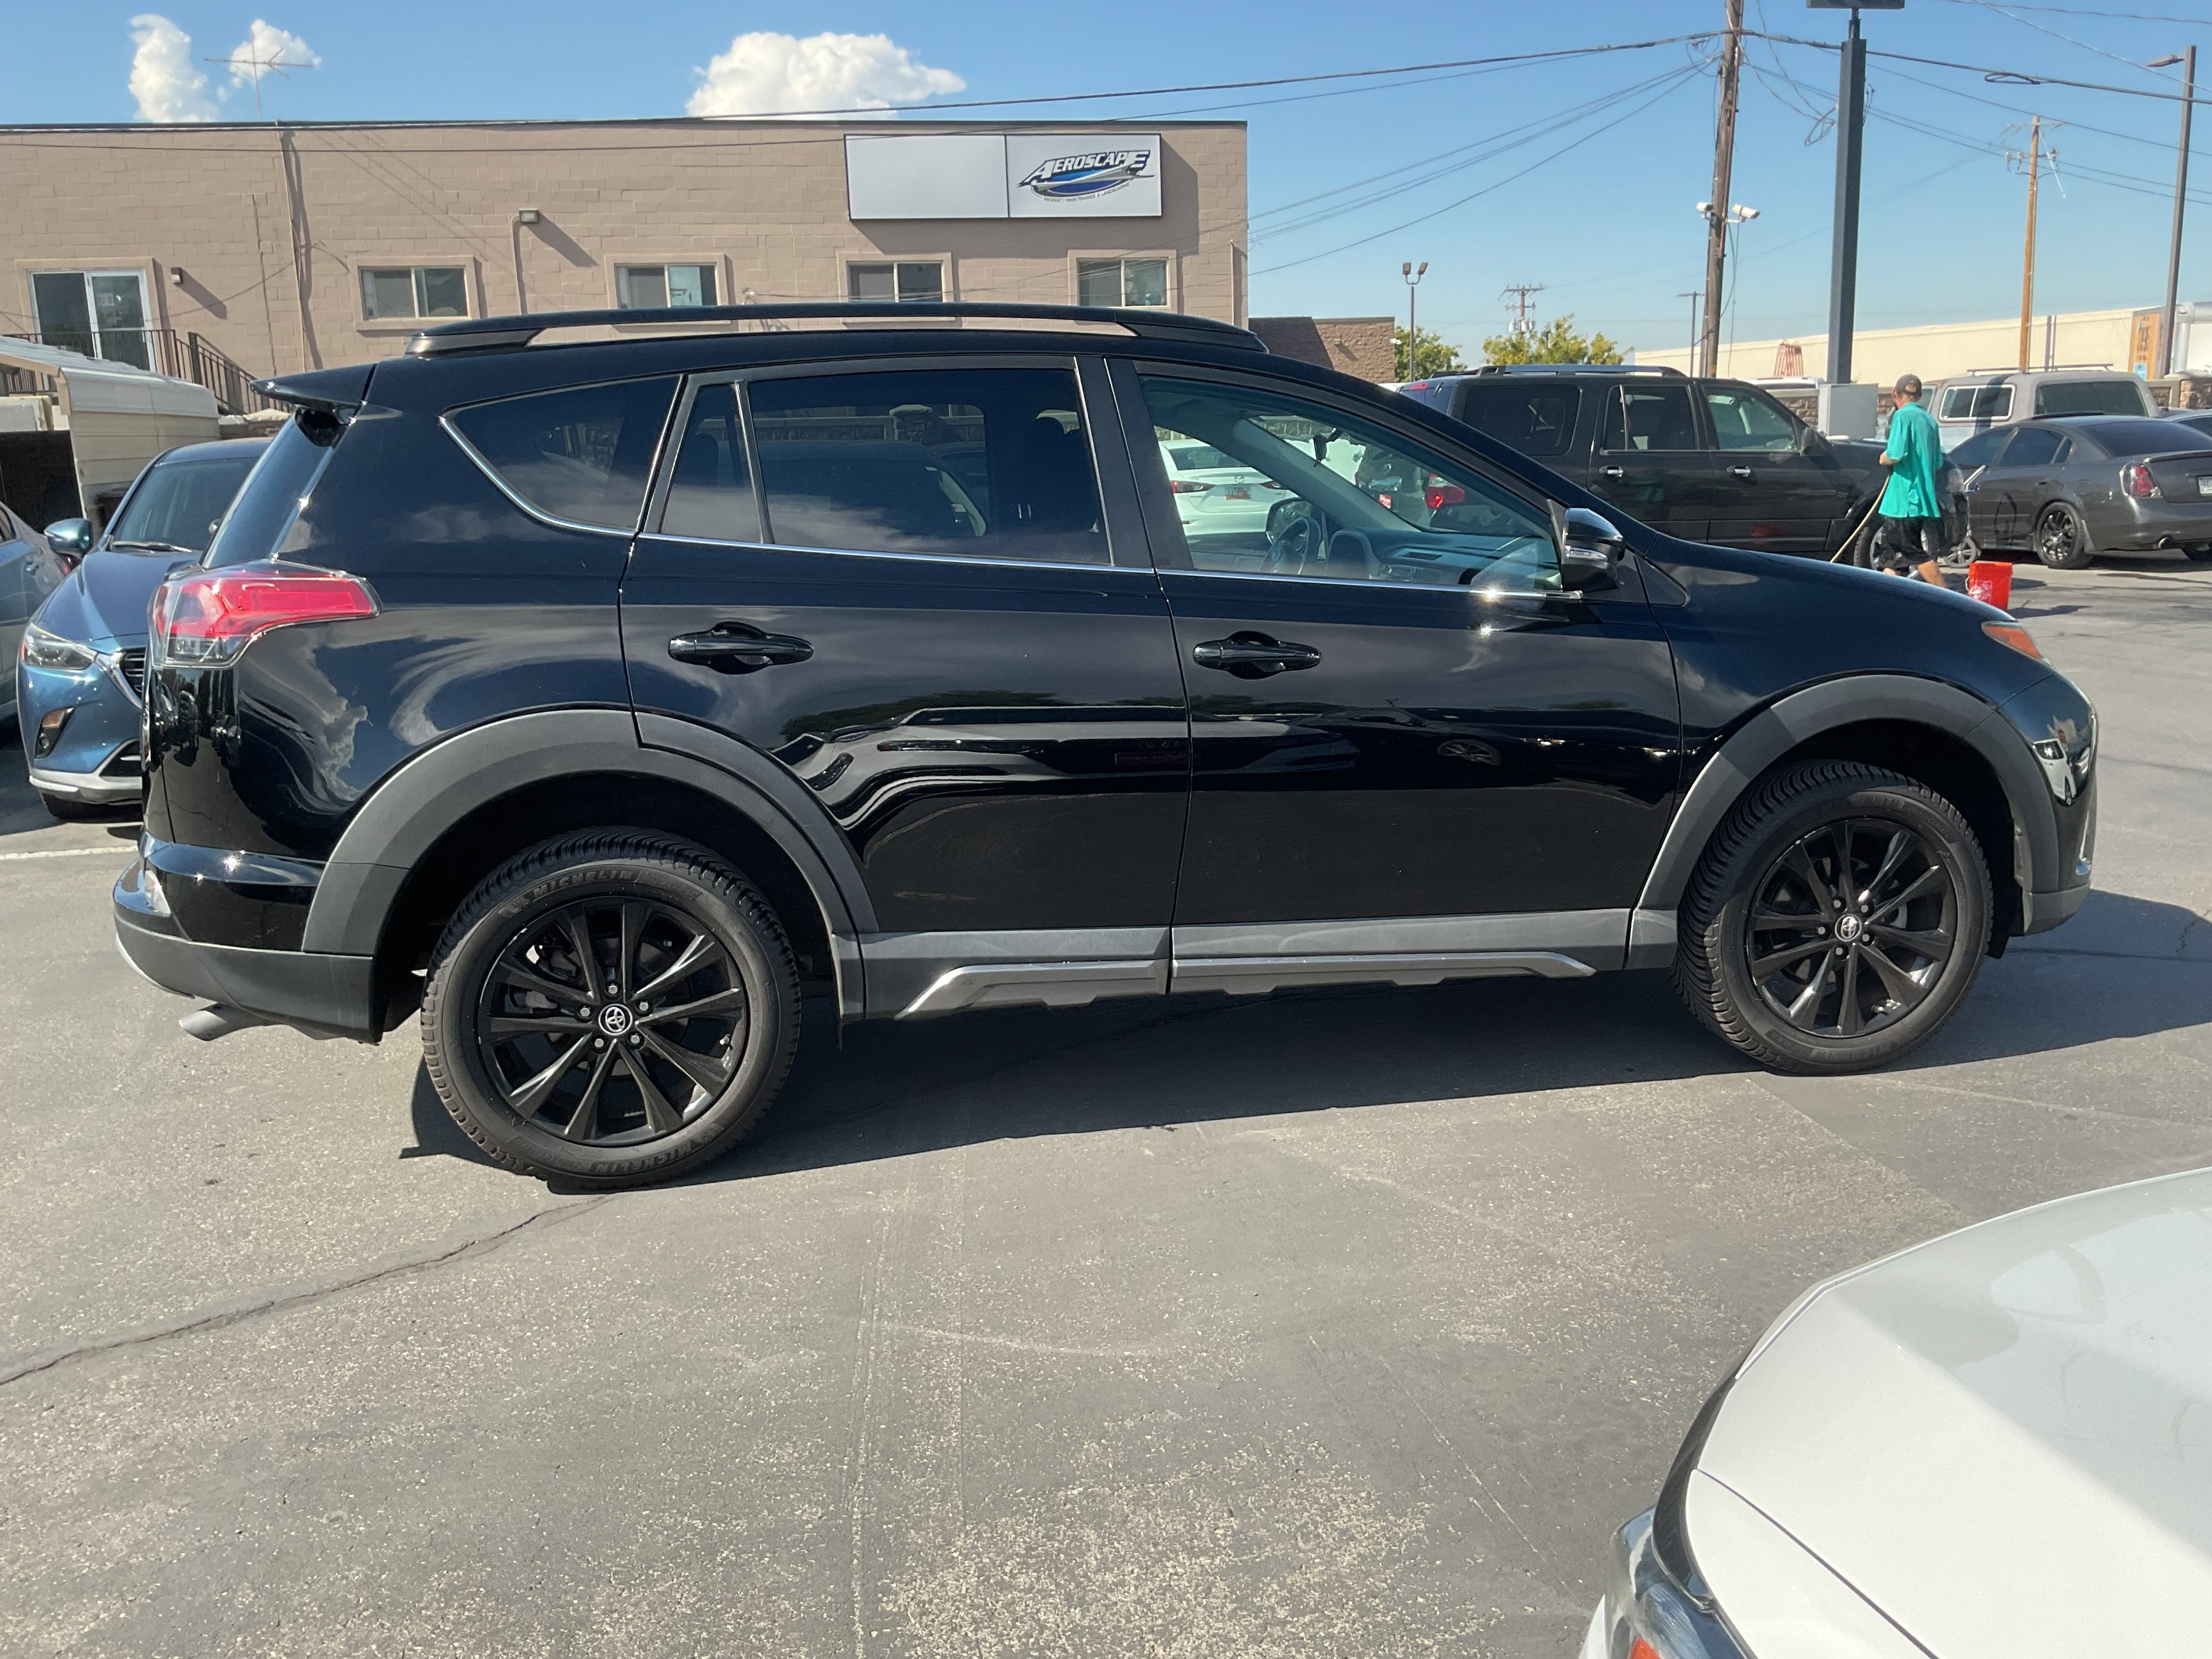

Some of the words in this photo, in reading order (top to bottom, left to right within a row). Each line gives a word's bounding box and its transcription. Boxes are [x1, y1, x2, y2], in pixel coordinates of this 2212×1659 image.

[1019, 150, 1150, 185] AEROSCAPE
[533, 870, 631, 898] MICHELIN
[595, 1143, 692, 1173] MICHELIN
